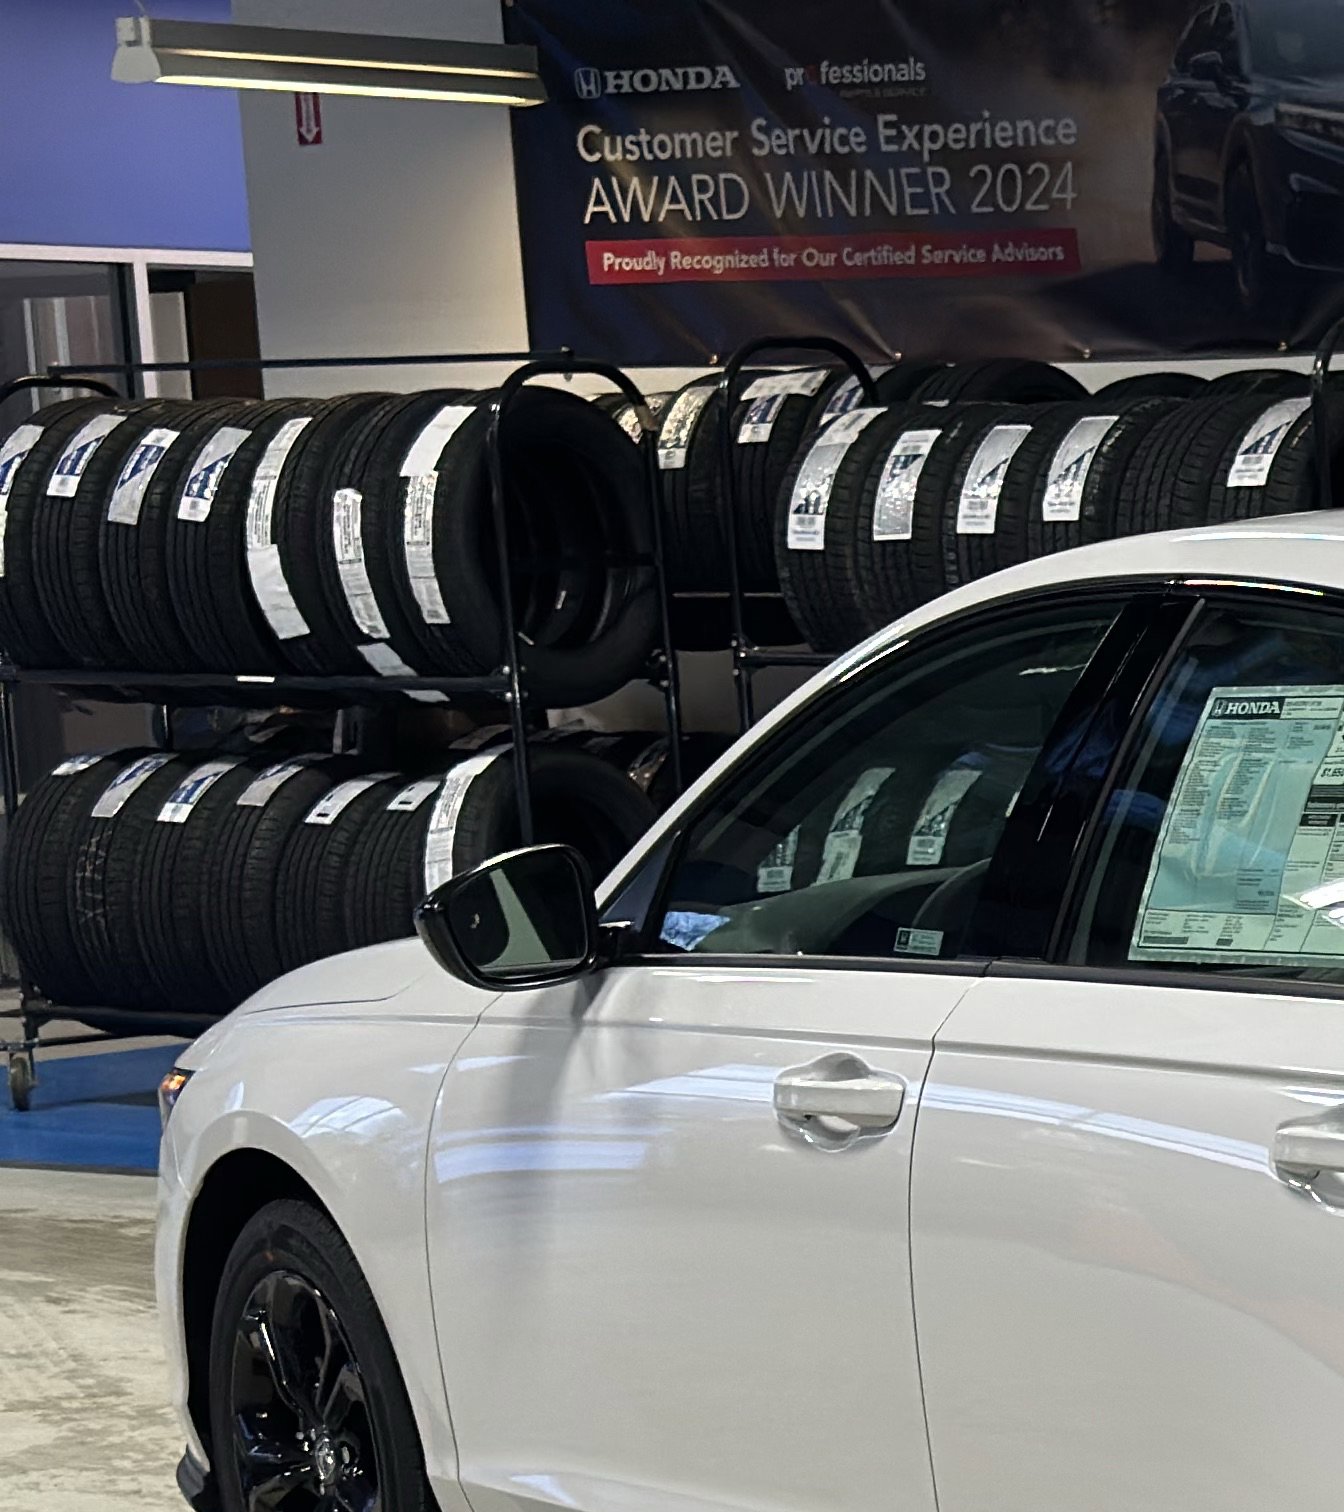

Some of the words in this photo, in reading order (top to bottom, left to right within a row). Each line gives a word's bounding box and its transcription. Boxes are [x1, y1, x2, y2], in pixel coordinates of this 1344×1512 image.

[604, 65, 740, 94] HONDA
[576, 124, 739, 162] Customer
[751, 116, 867, 155] Service
[876, 109, 1078, 163] Experience
[583, 172, 750, 225] AWARD
[763, 165, 956, 220] WINNER
[968, 161, 1078, 214] 2024
[602, 250, 666, 276] Proudly
[669, 249, 769, 275] Recognized
[774, 249, 795, 268] for
[801, 247, 837, 267] Our
[842, 245, 916, 266] Certified
[920, 243, 987, 264] Service
[991, 241, 1065, 263] Advisors
[1225, 701, 1281, 715] HONDA
